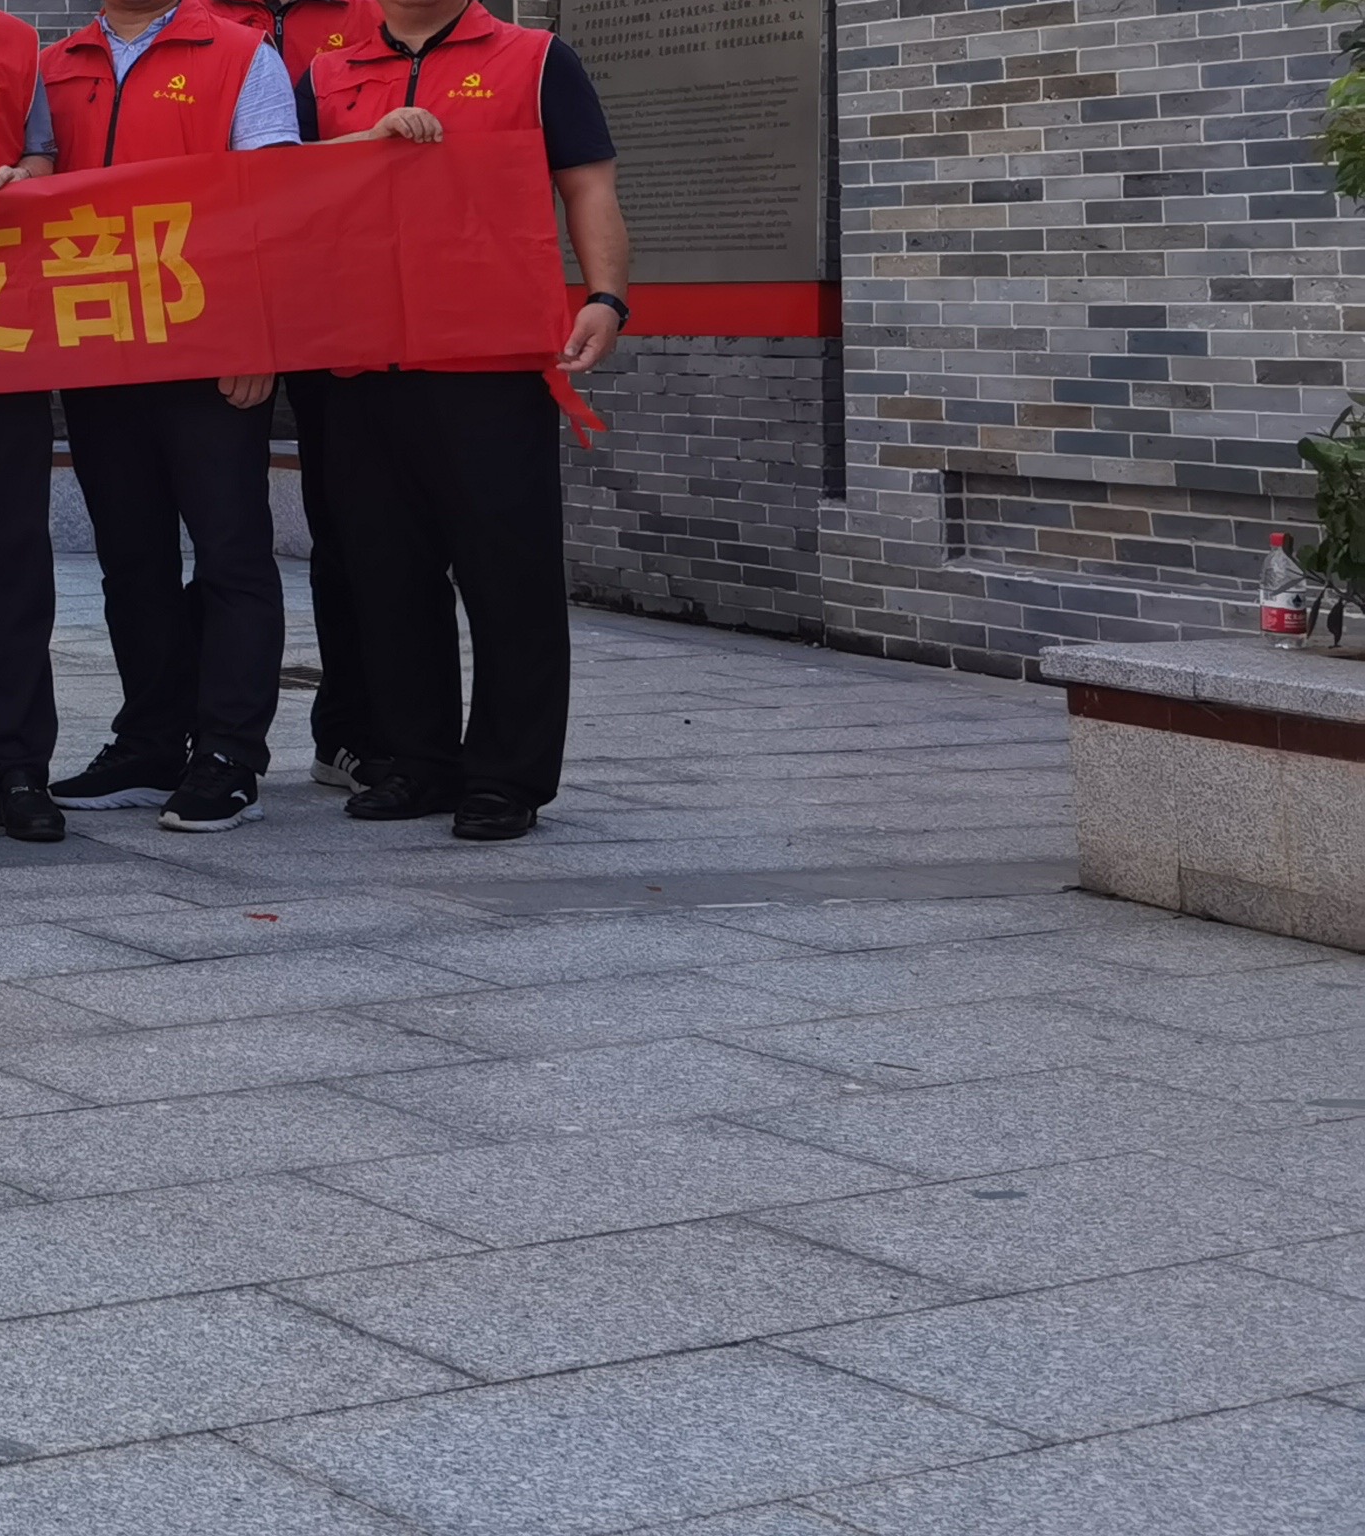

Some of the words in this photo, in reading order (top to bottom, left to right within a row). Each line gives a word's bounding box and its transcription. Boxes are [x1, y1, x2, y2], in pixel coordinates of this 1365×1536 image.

[153, 90, 195, 105] 为人民服务
[447, 89, 494, 99] 为人民服务
